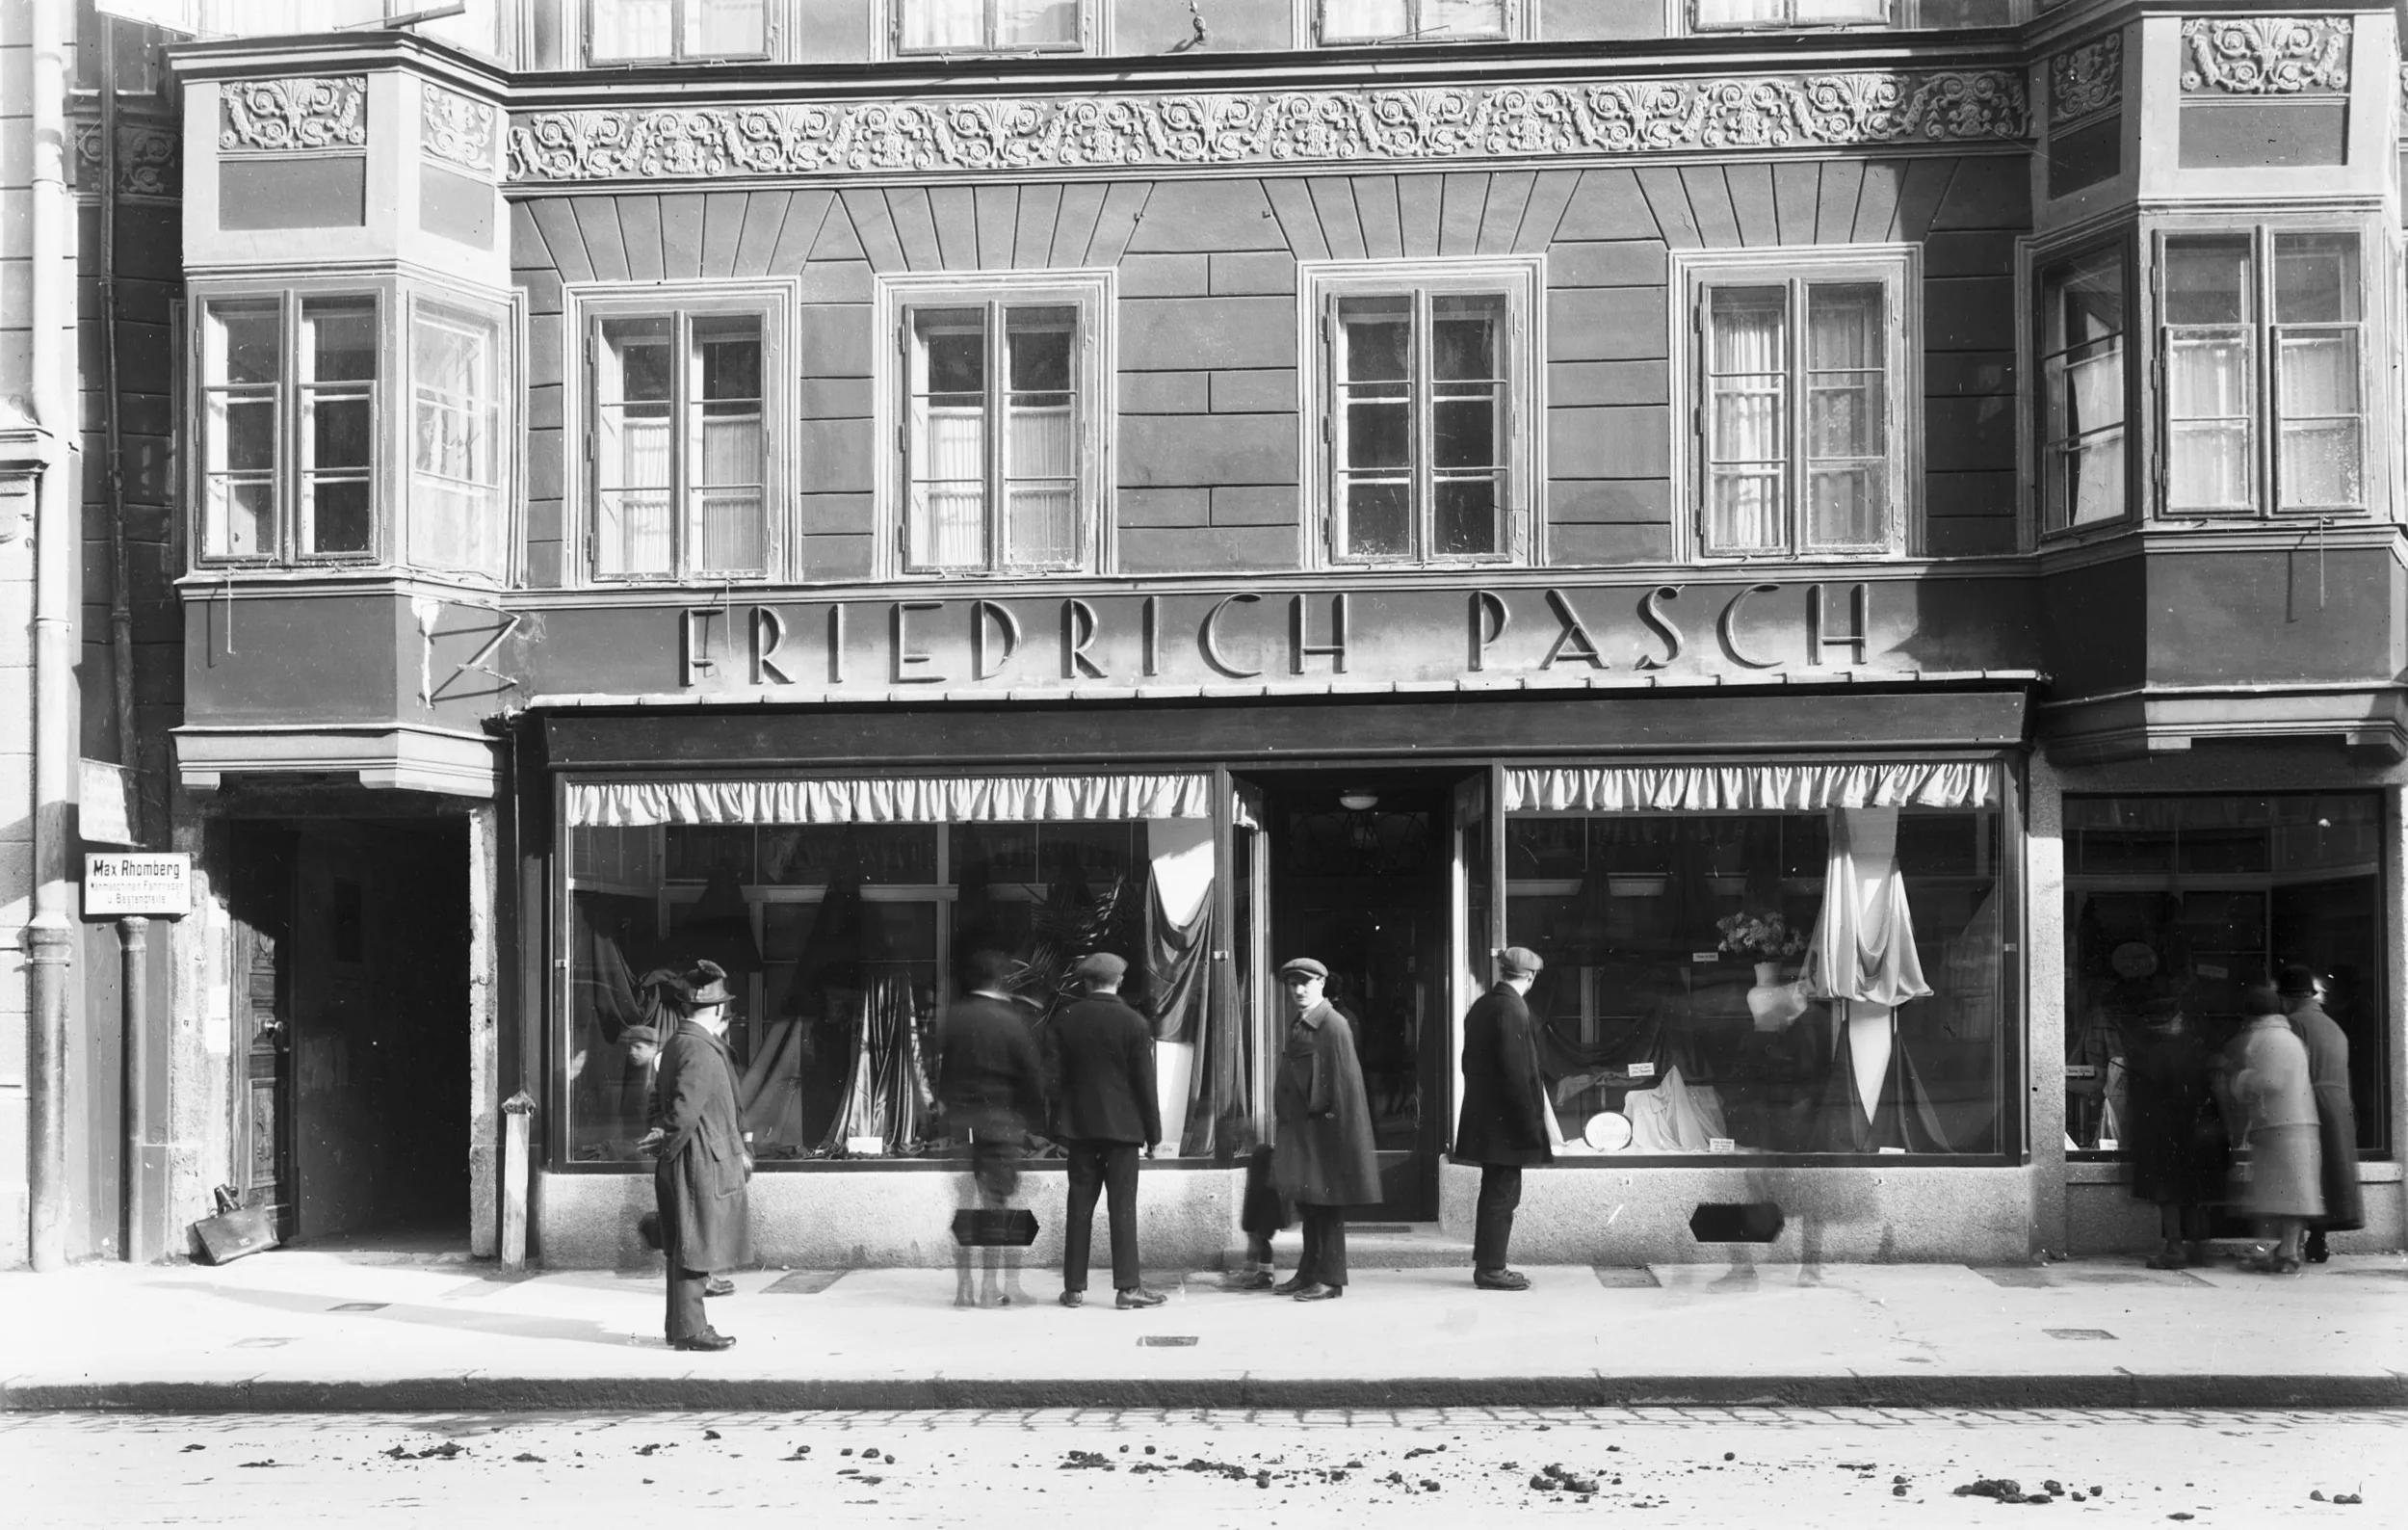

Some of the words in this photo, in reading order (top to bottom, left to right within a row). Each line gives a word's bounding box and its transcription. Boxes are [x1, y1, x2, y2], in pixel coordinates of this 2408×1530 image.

[681, 592, 1348, 687] FRIEDRICH
[1470, 582, 1869, 673] PASCH
[93, 859, 117, 877] Max
[121, 859, 180, 880] Rhomberg
